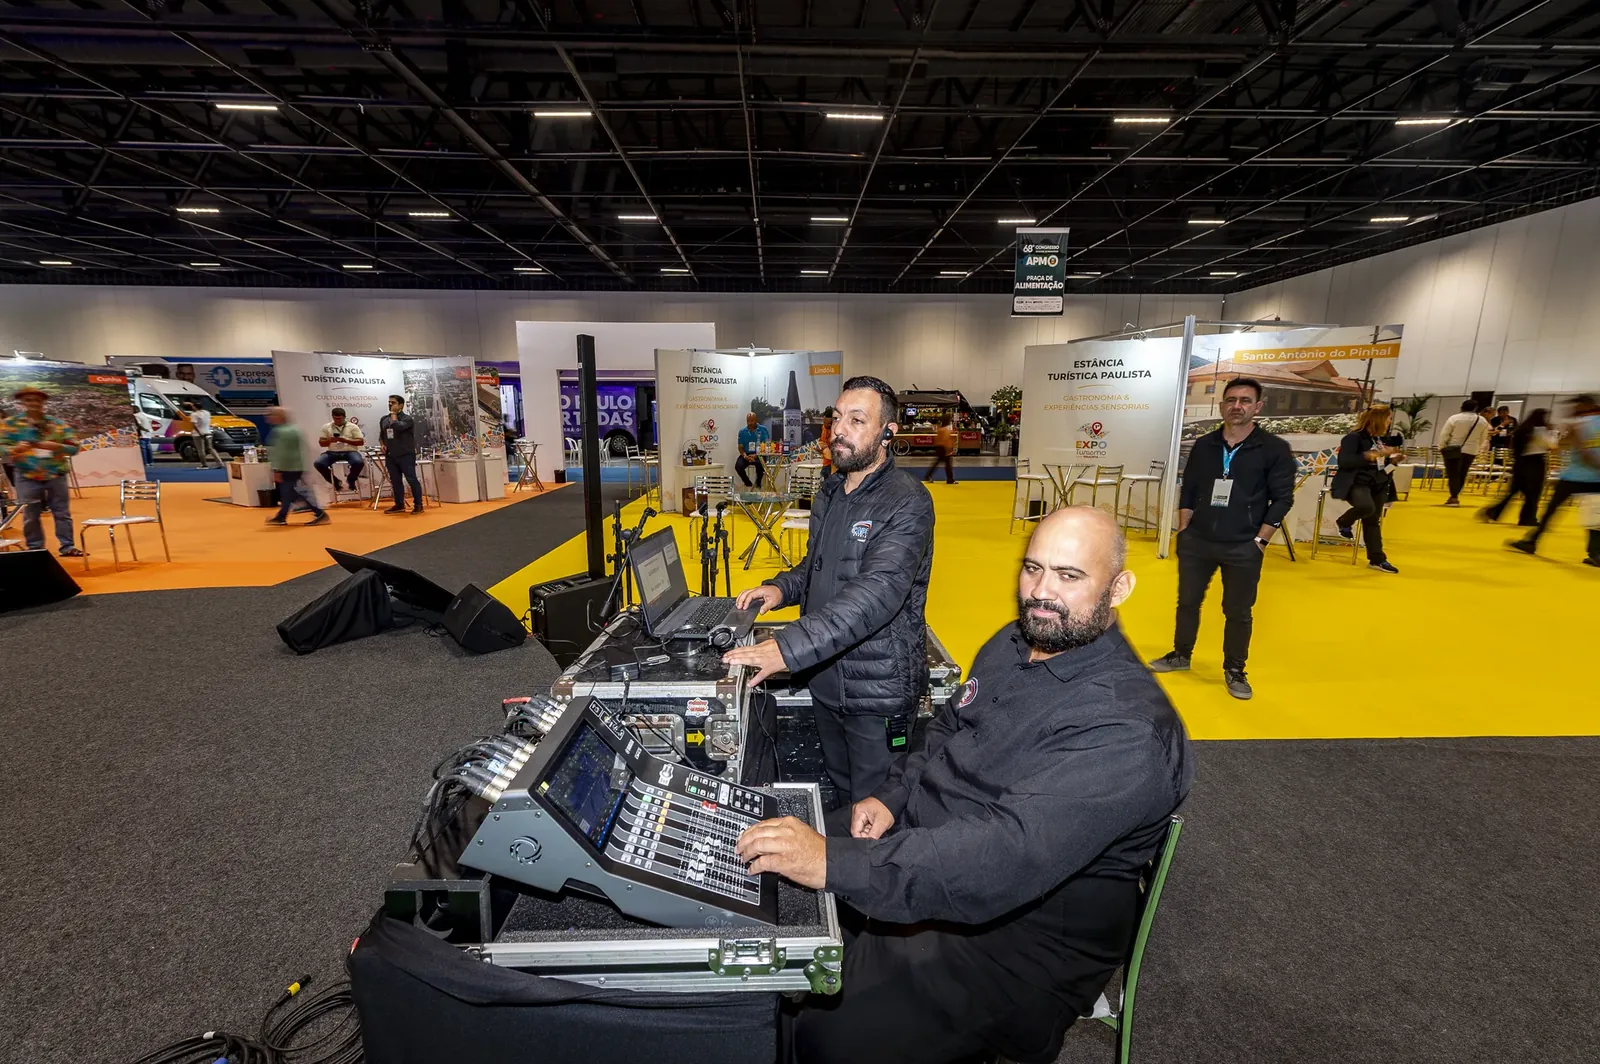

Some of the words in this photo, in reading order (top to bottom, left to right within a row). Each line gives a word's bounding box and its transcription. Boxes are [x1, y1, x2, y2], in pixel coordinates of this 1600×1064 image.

[1015, 281, 1063, 290] ALIMENTAÇÃO
[1242, 352, 1276, 361] Santo
[1278, 349, 1327, 359] Antônio
[1329, 349, 1346, 358] do
[1349, 346, 1392, 357] Pinhal
[1073, 358, 1125, 368] ESTÂNCIA
[323, 365, 365, 375] ESTÂNCIA
[692, 366, 722, 374] ESTÂNCIA
[814, 366, 835, 374] Lindóia
[236, 376, 267, 384] Saúde
[302, 375, 347, 383] TURÍSTICA
[348, 377, 386, 385] PAULISTA
[675, 375, 709, 384] TURÍSTICA
[709, 377, 738, 385] PAULISTA
[1047, 370, 1098, 381] TURÍSTICA
[1100, 370, 1152, 379] PAULISTA
[1062, 393, 1122, 402] GASTRONOMIA
[1043, 402, 1099, 411] EXPERIÊNCIAS
[573, 411, 633, 426] TDAS
[1075, 440, 1107, 449] EXPO
